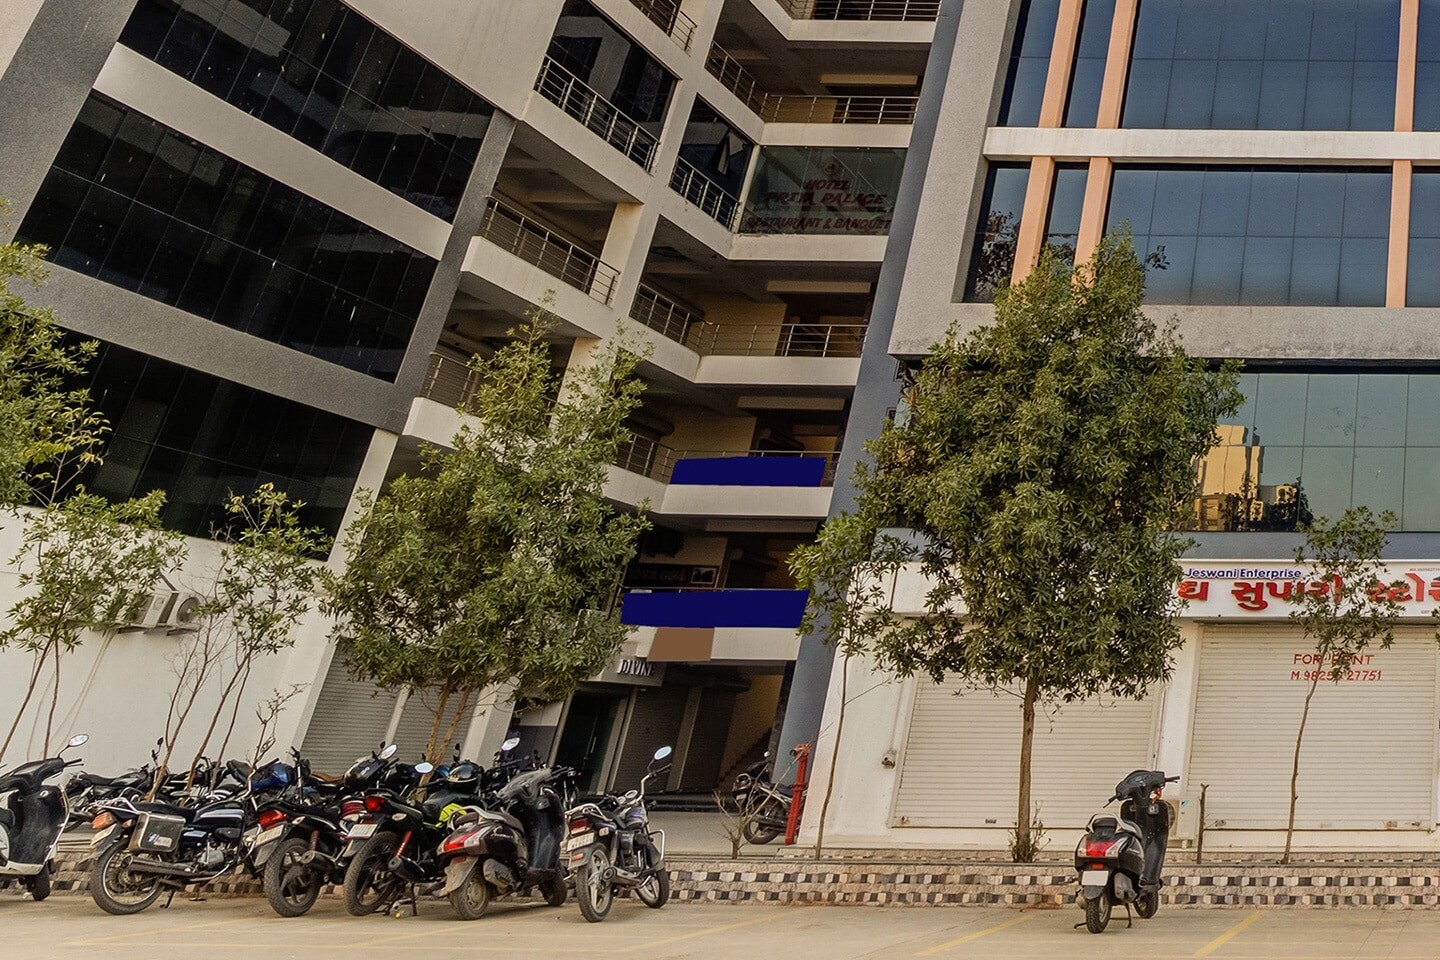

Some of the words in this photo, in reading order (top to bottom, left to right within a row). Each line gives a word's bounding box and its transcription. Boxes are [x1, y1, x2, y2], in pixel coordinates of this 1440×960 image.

[804, 178, 850, 190] HOTEL
[1185, 568, 1237, 578] Jeswani
[1239, 568, 1302, 580] Enterprise
[1293, 653, 1324, 665] FOR
